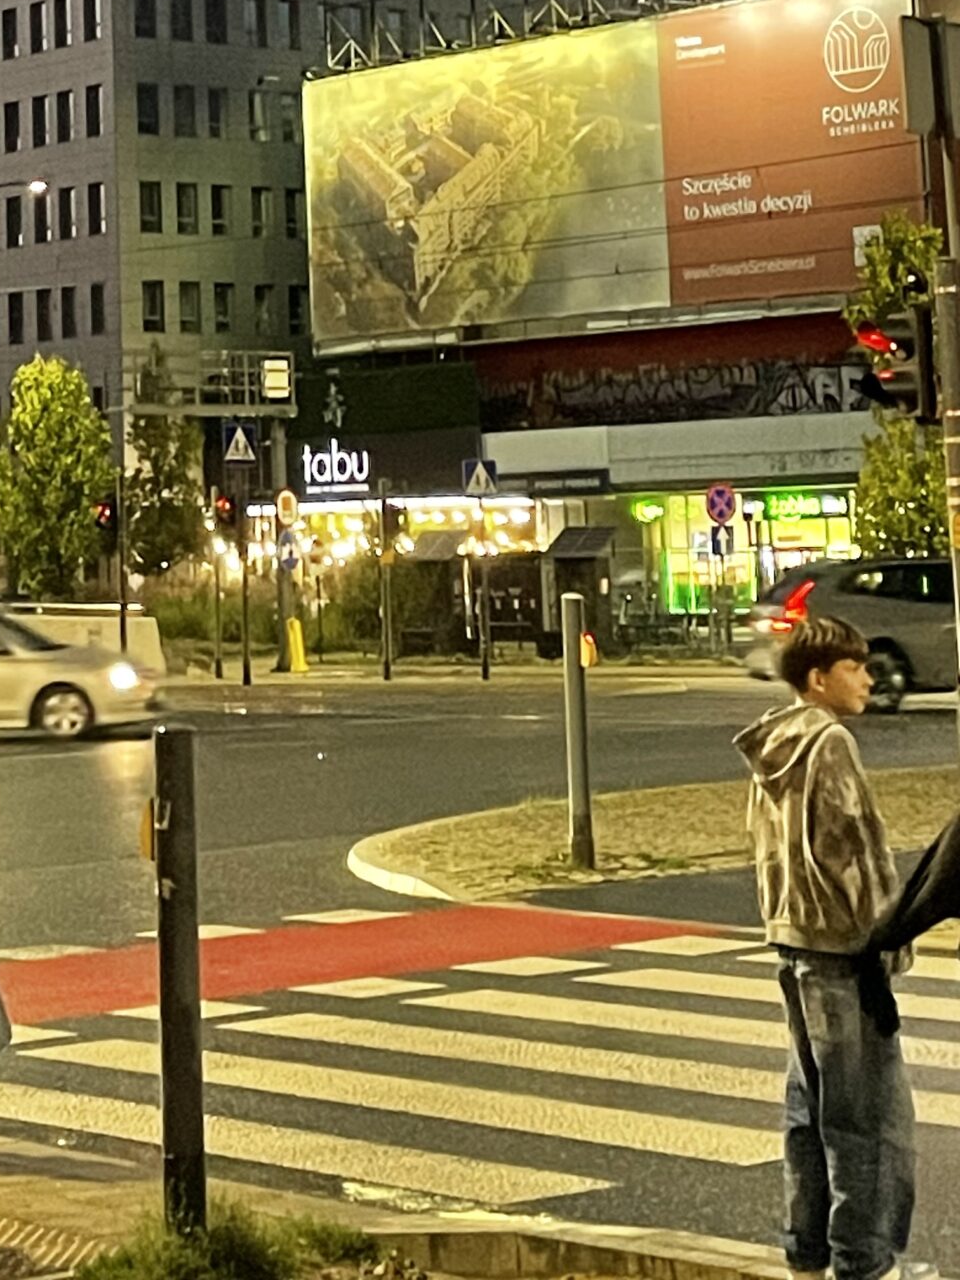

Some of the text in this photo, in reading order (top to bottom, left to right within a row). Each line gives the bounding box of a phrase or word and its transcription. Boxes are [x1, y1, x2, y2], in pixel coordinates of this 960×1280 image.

[822, 98, 900, 126] FOLWARK
[682, 172, 752, 196] Szczęście
[684, 190, 813, 221] to kwestia decyzji
[302, 437, 369, 484] tabu
